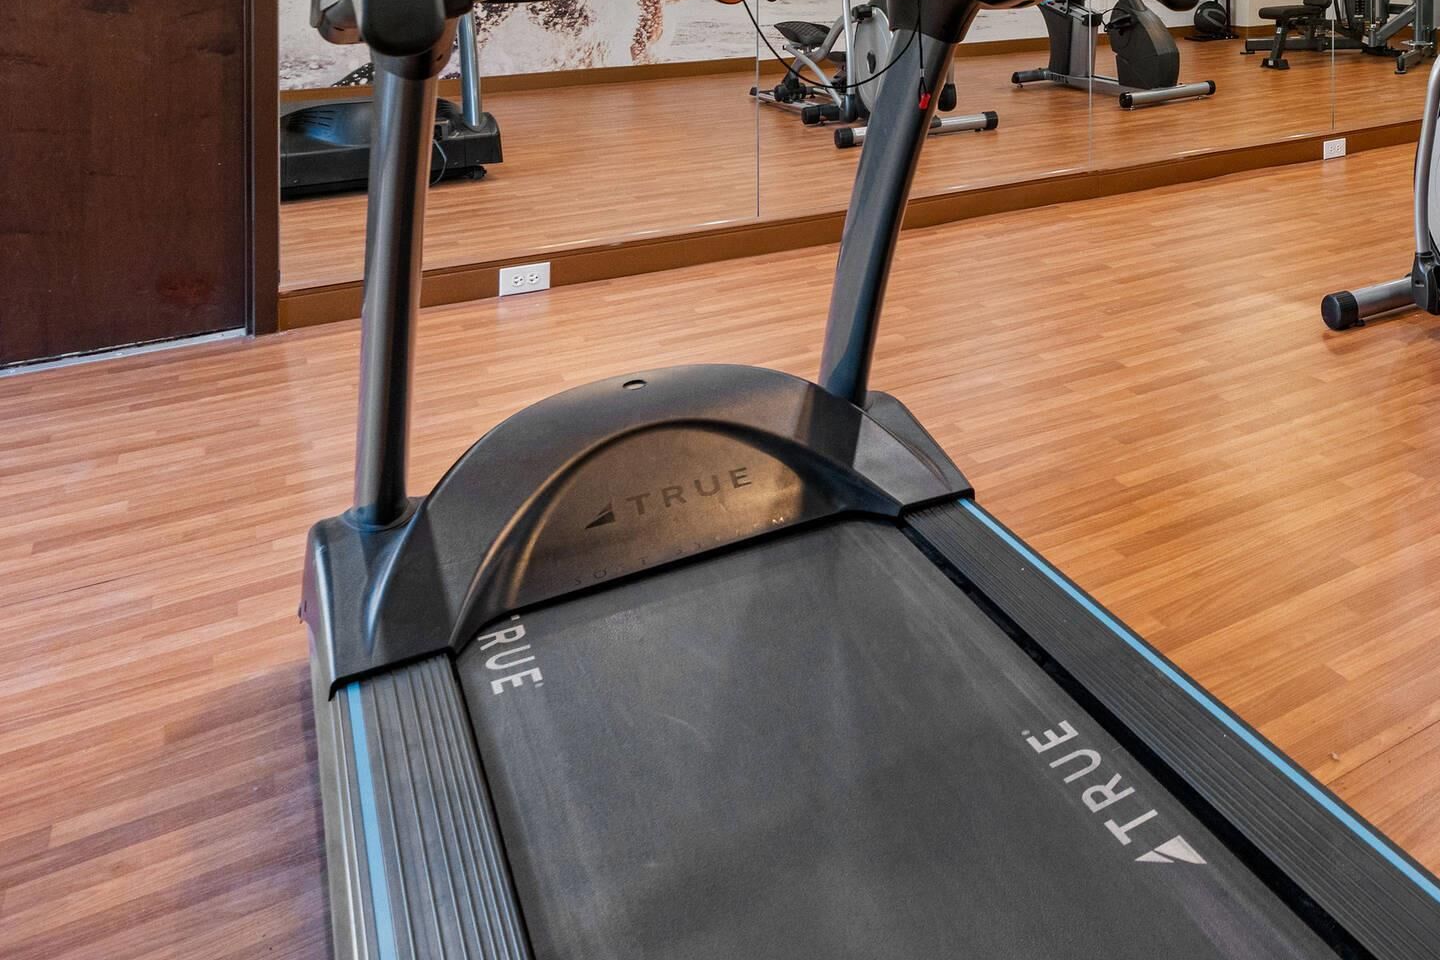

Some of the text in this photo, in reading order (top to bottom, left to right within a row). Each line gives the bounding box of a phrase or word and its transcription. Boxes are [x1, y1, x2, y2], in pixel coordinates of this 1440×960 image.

[626, 467, 752, 516] TRUE
[477, 614, 544, 695] RUE
[1026, 719, 1158, 846] TRUE
